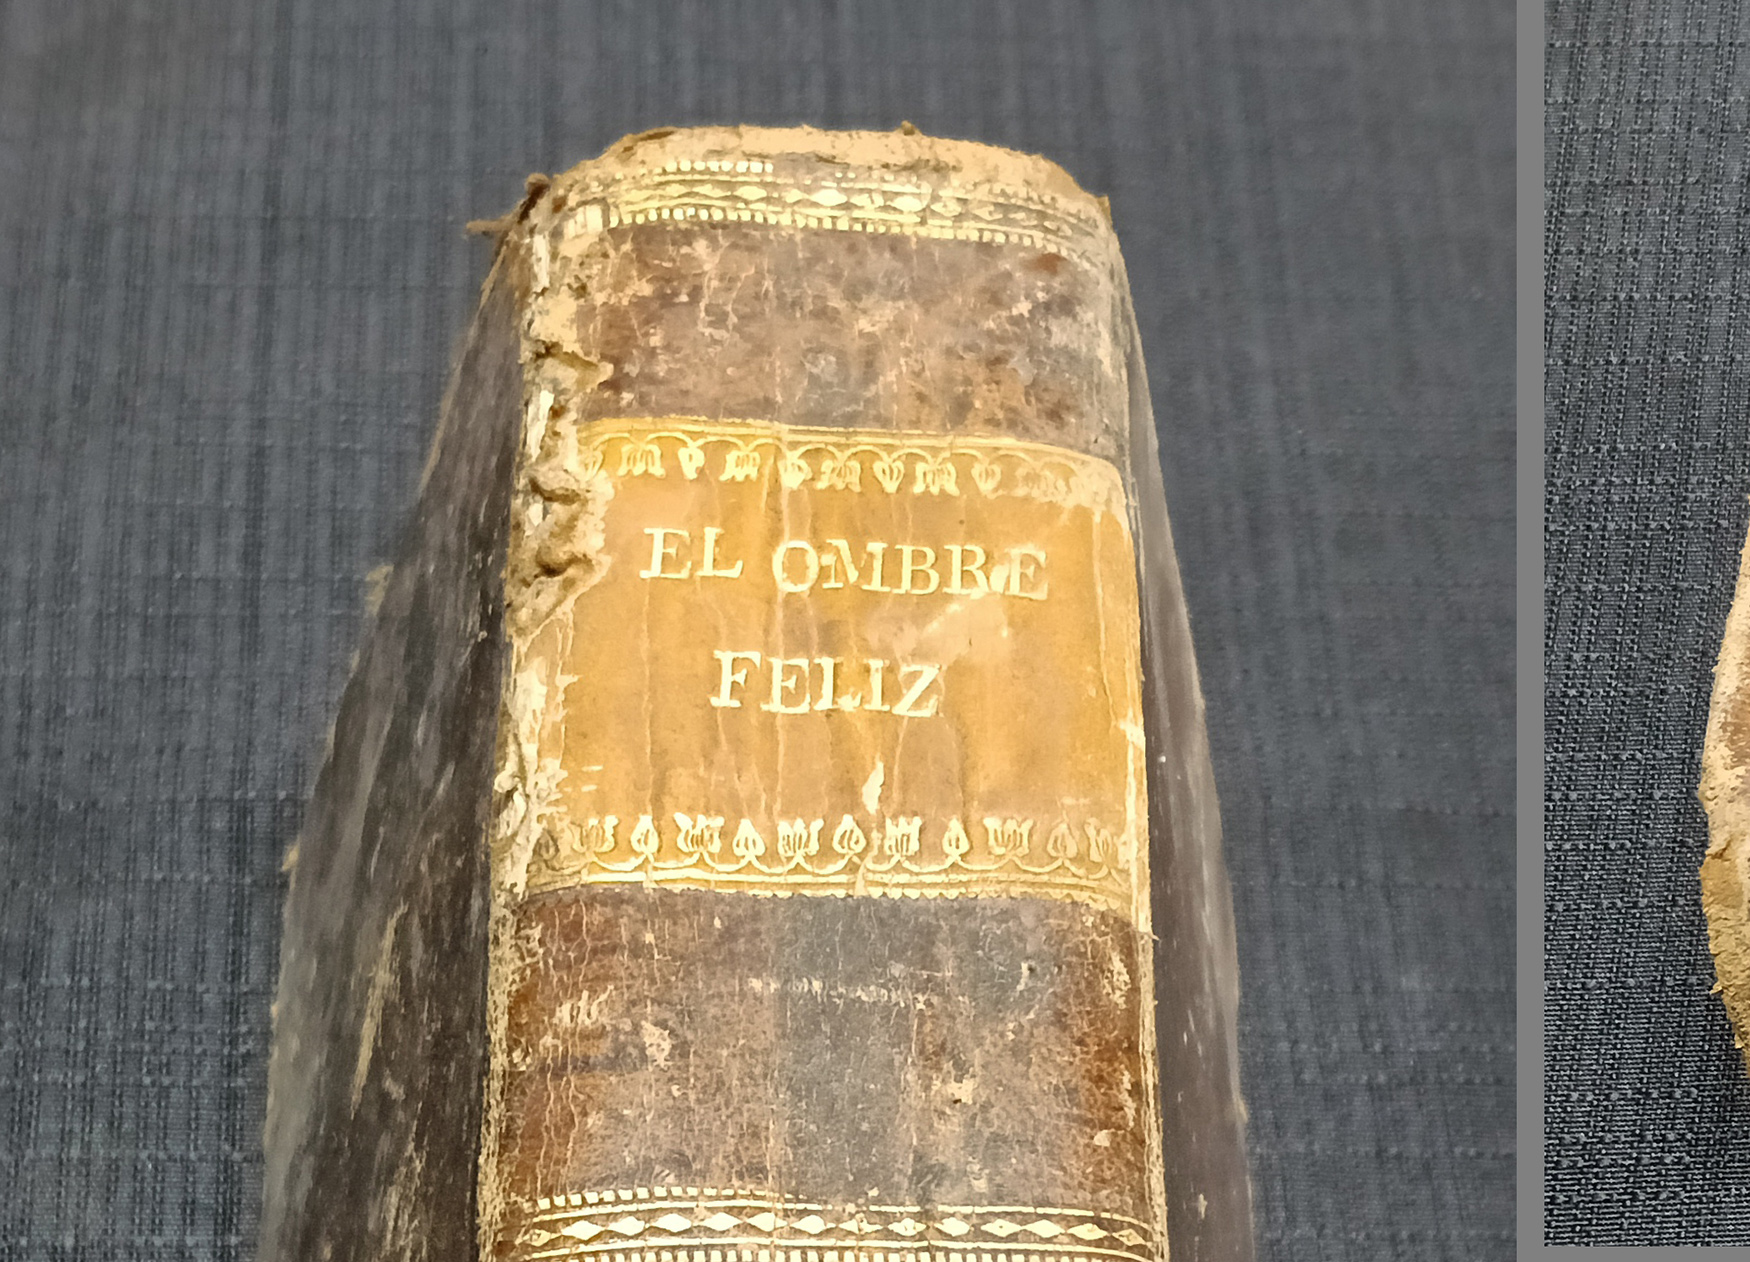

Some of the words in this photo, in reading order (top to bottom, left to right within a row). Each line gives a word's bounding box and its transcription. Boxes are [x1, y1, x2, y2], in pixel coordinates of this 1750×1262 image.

[639, 526, 744, 579] EL
[771, 537, 1049, 601] OMBRE
[709, 650, 942, 718] FELIZ
